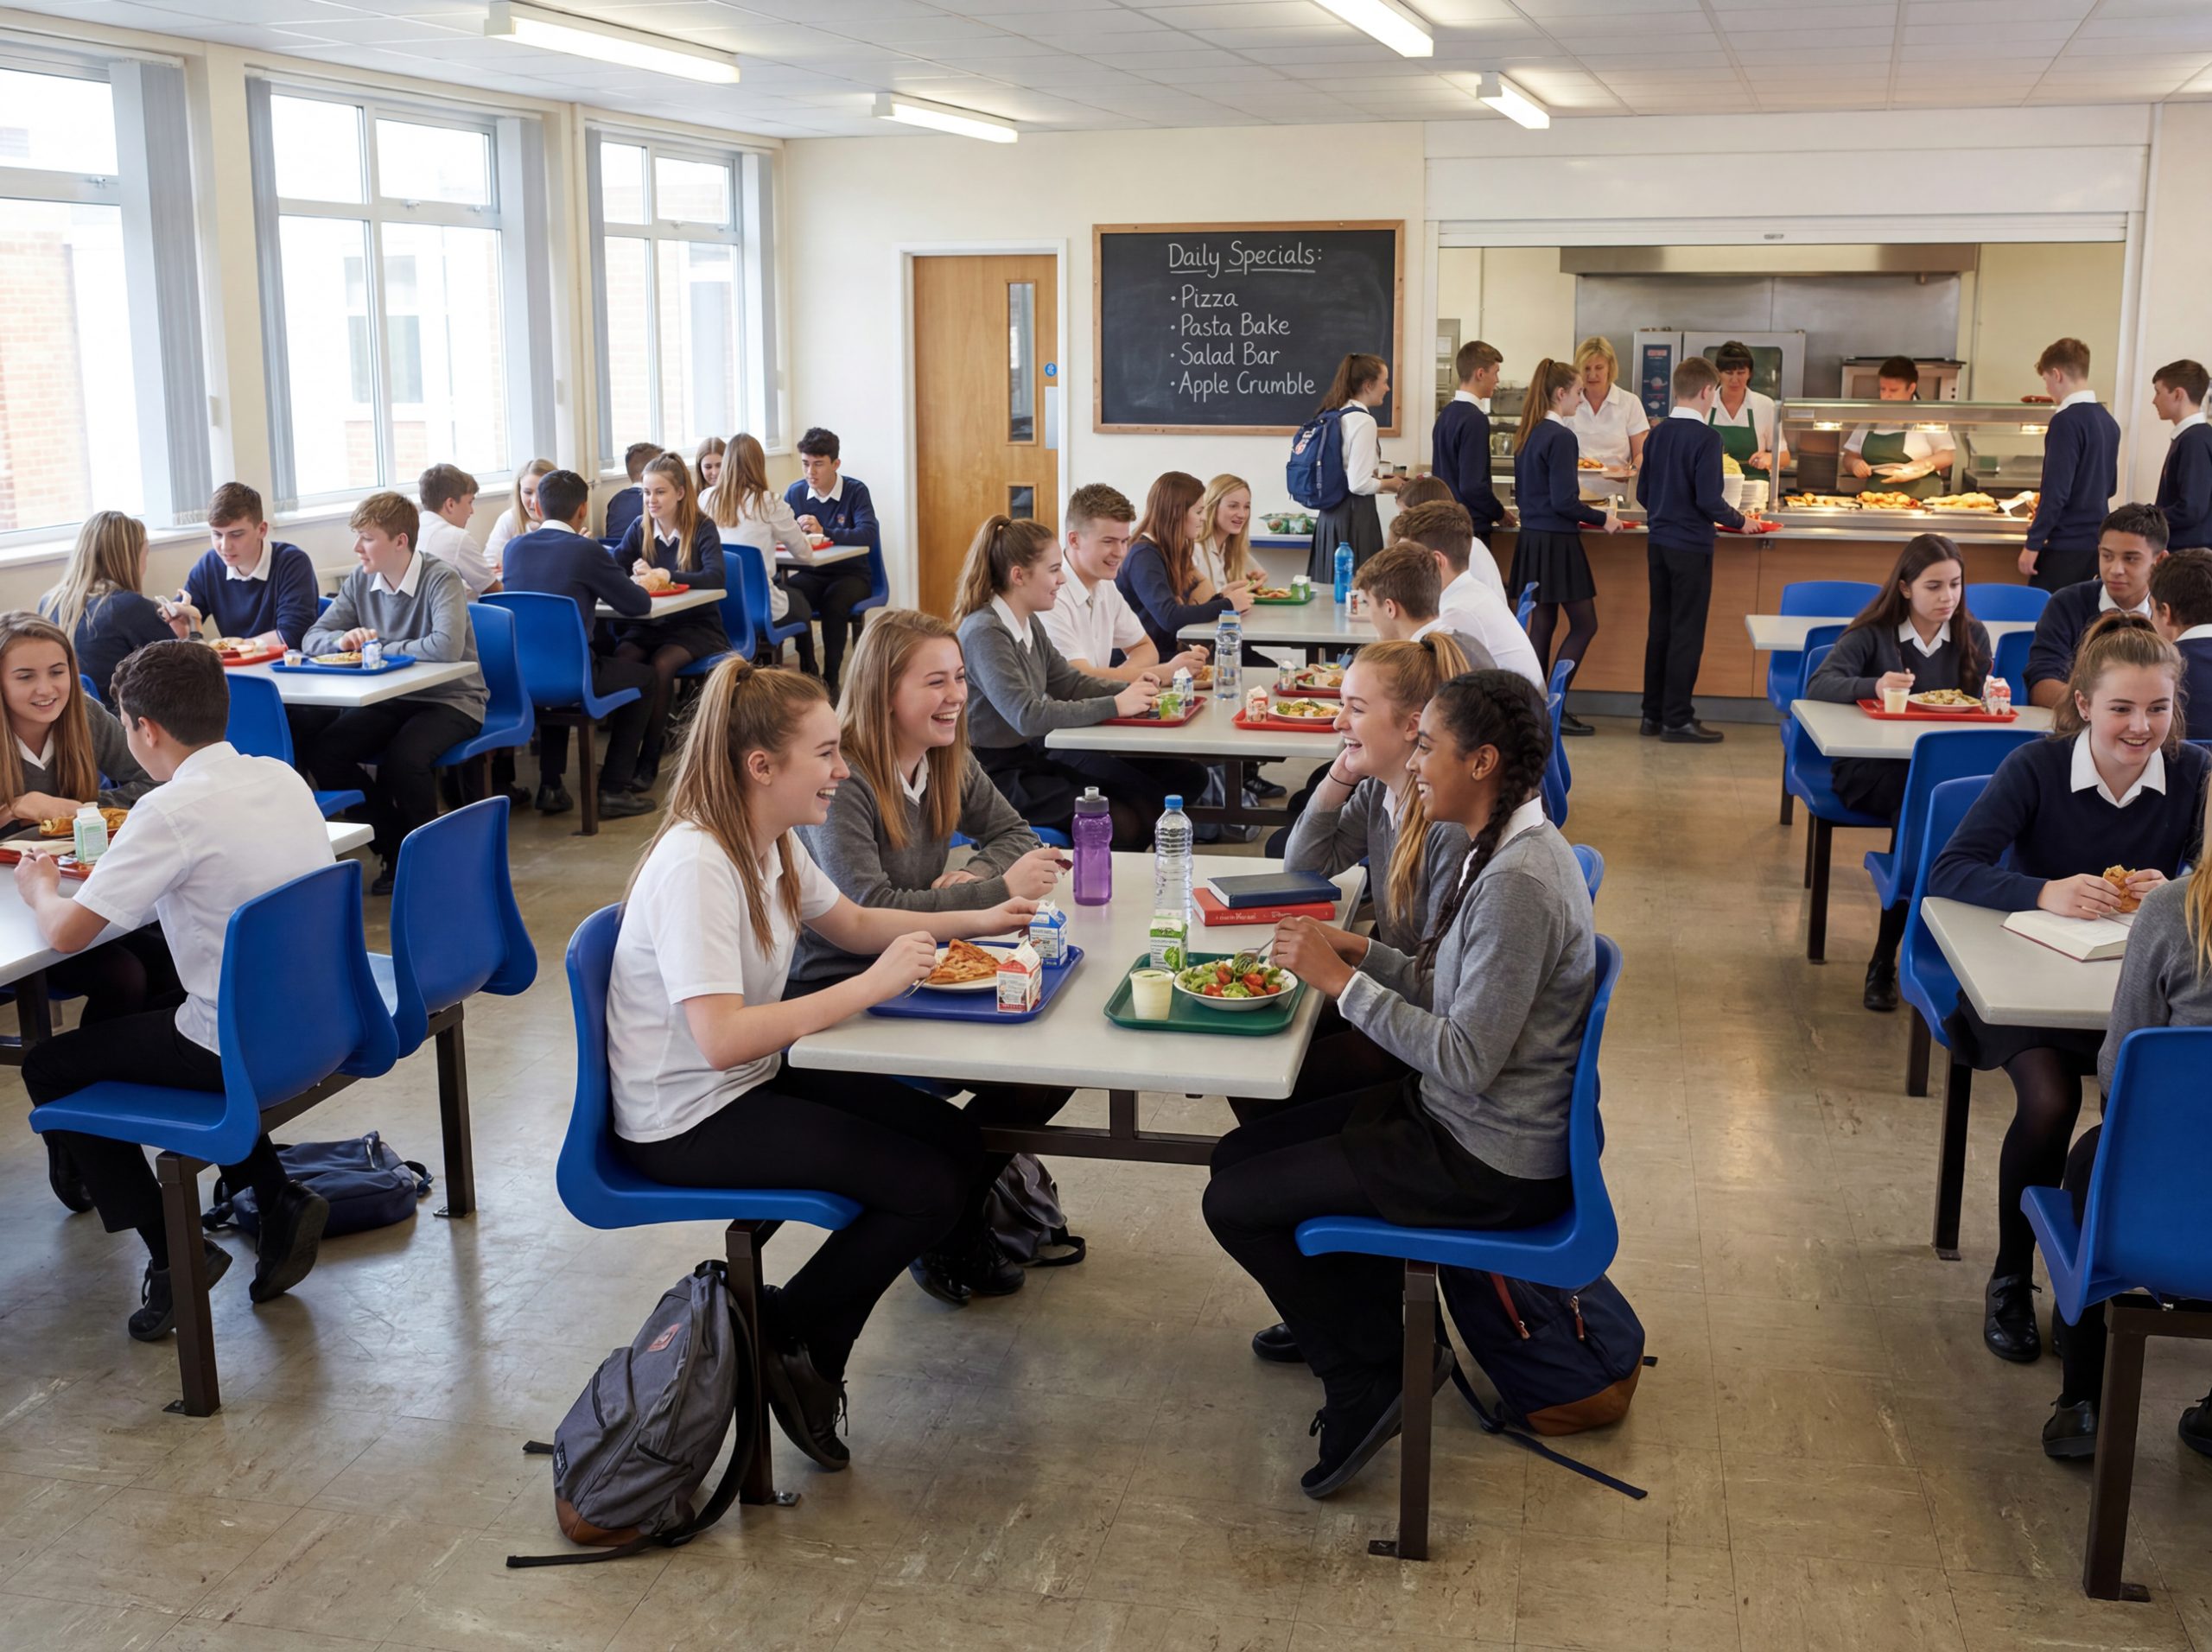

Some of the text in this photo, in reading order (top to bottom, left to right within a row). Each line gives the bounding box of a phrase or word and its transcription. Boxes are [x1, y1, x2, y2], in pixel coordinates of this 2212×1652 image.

[1168, 240, 1323, 278] Daily Specials:
[1181, 284, 1238, 308] Pizza
[1180, 313, 1291, 336] Pasta Bake
[1180, 341, 1281, 365] Salad Bar
[1179, 371, 1316, 403] Apple Crumble
